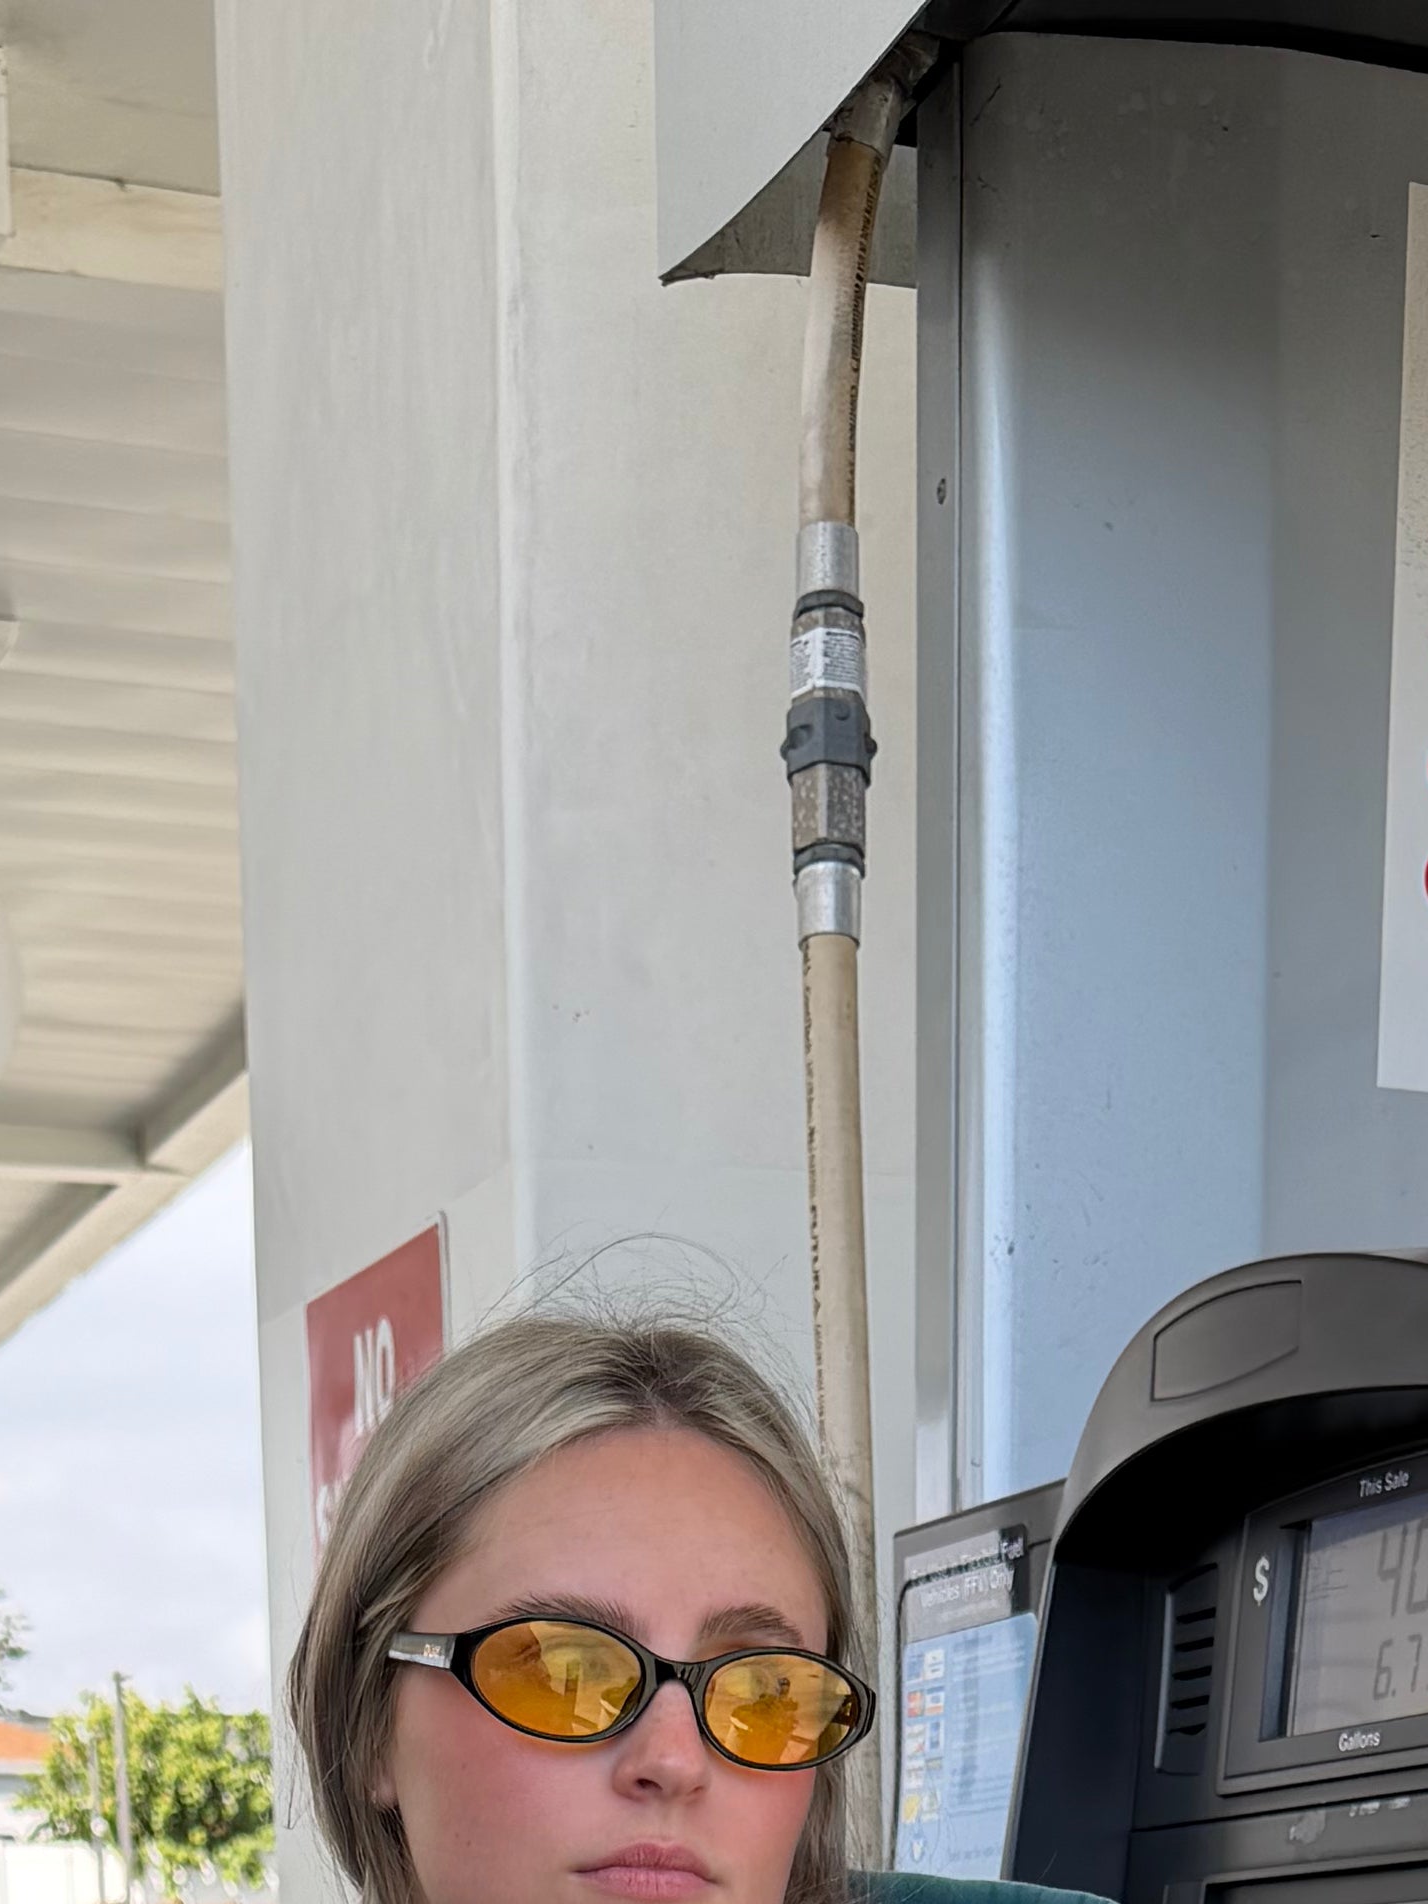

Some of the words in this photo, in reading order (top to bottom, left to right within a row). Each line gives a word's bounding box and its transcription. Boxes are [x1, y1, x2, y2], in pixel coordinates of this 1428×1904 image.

[353, 1315, 396, 1437] NO
[1359, 1479, 1382, 1498] This
[1385, 1470, 1410, 1492] Sale
[1253, 1555, 1270, 1606] $
[1339, 1730, 1380, 1752] Gallons
